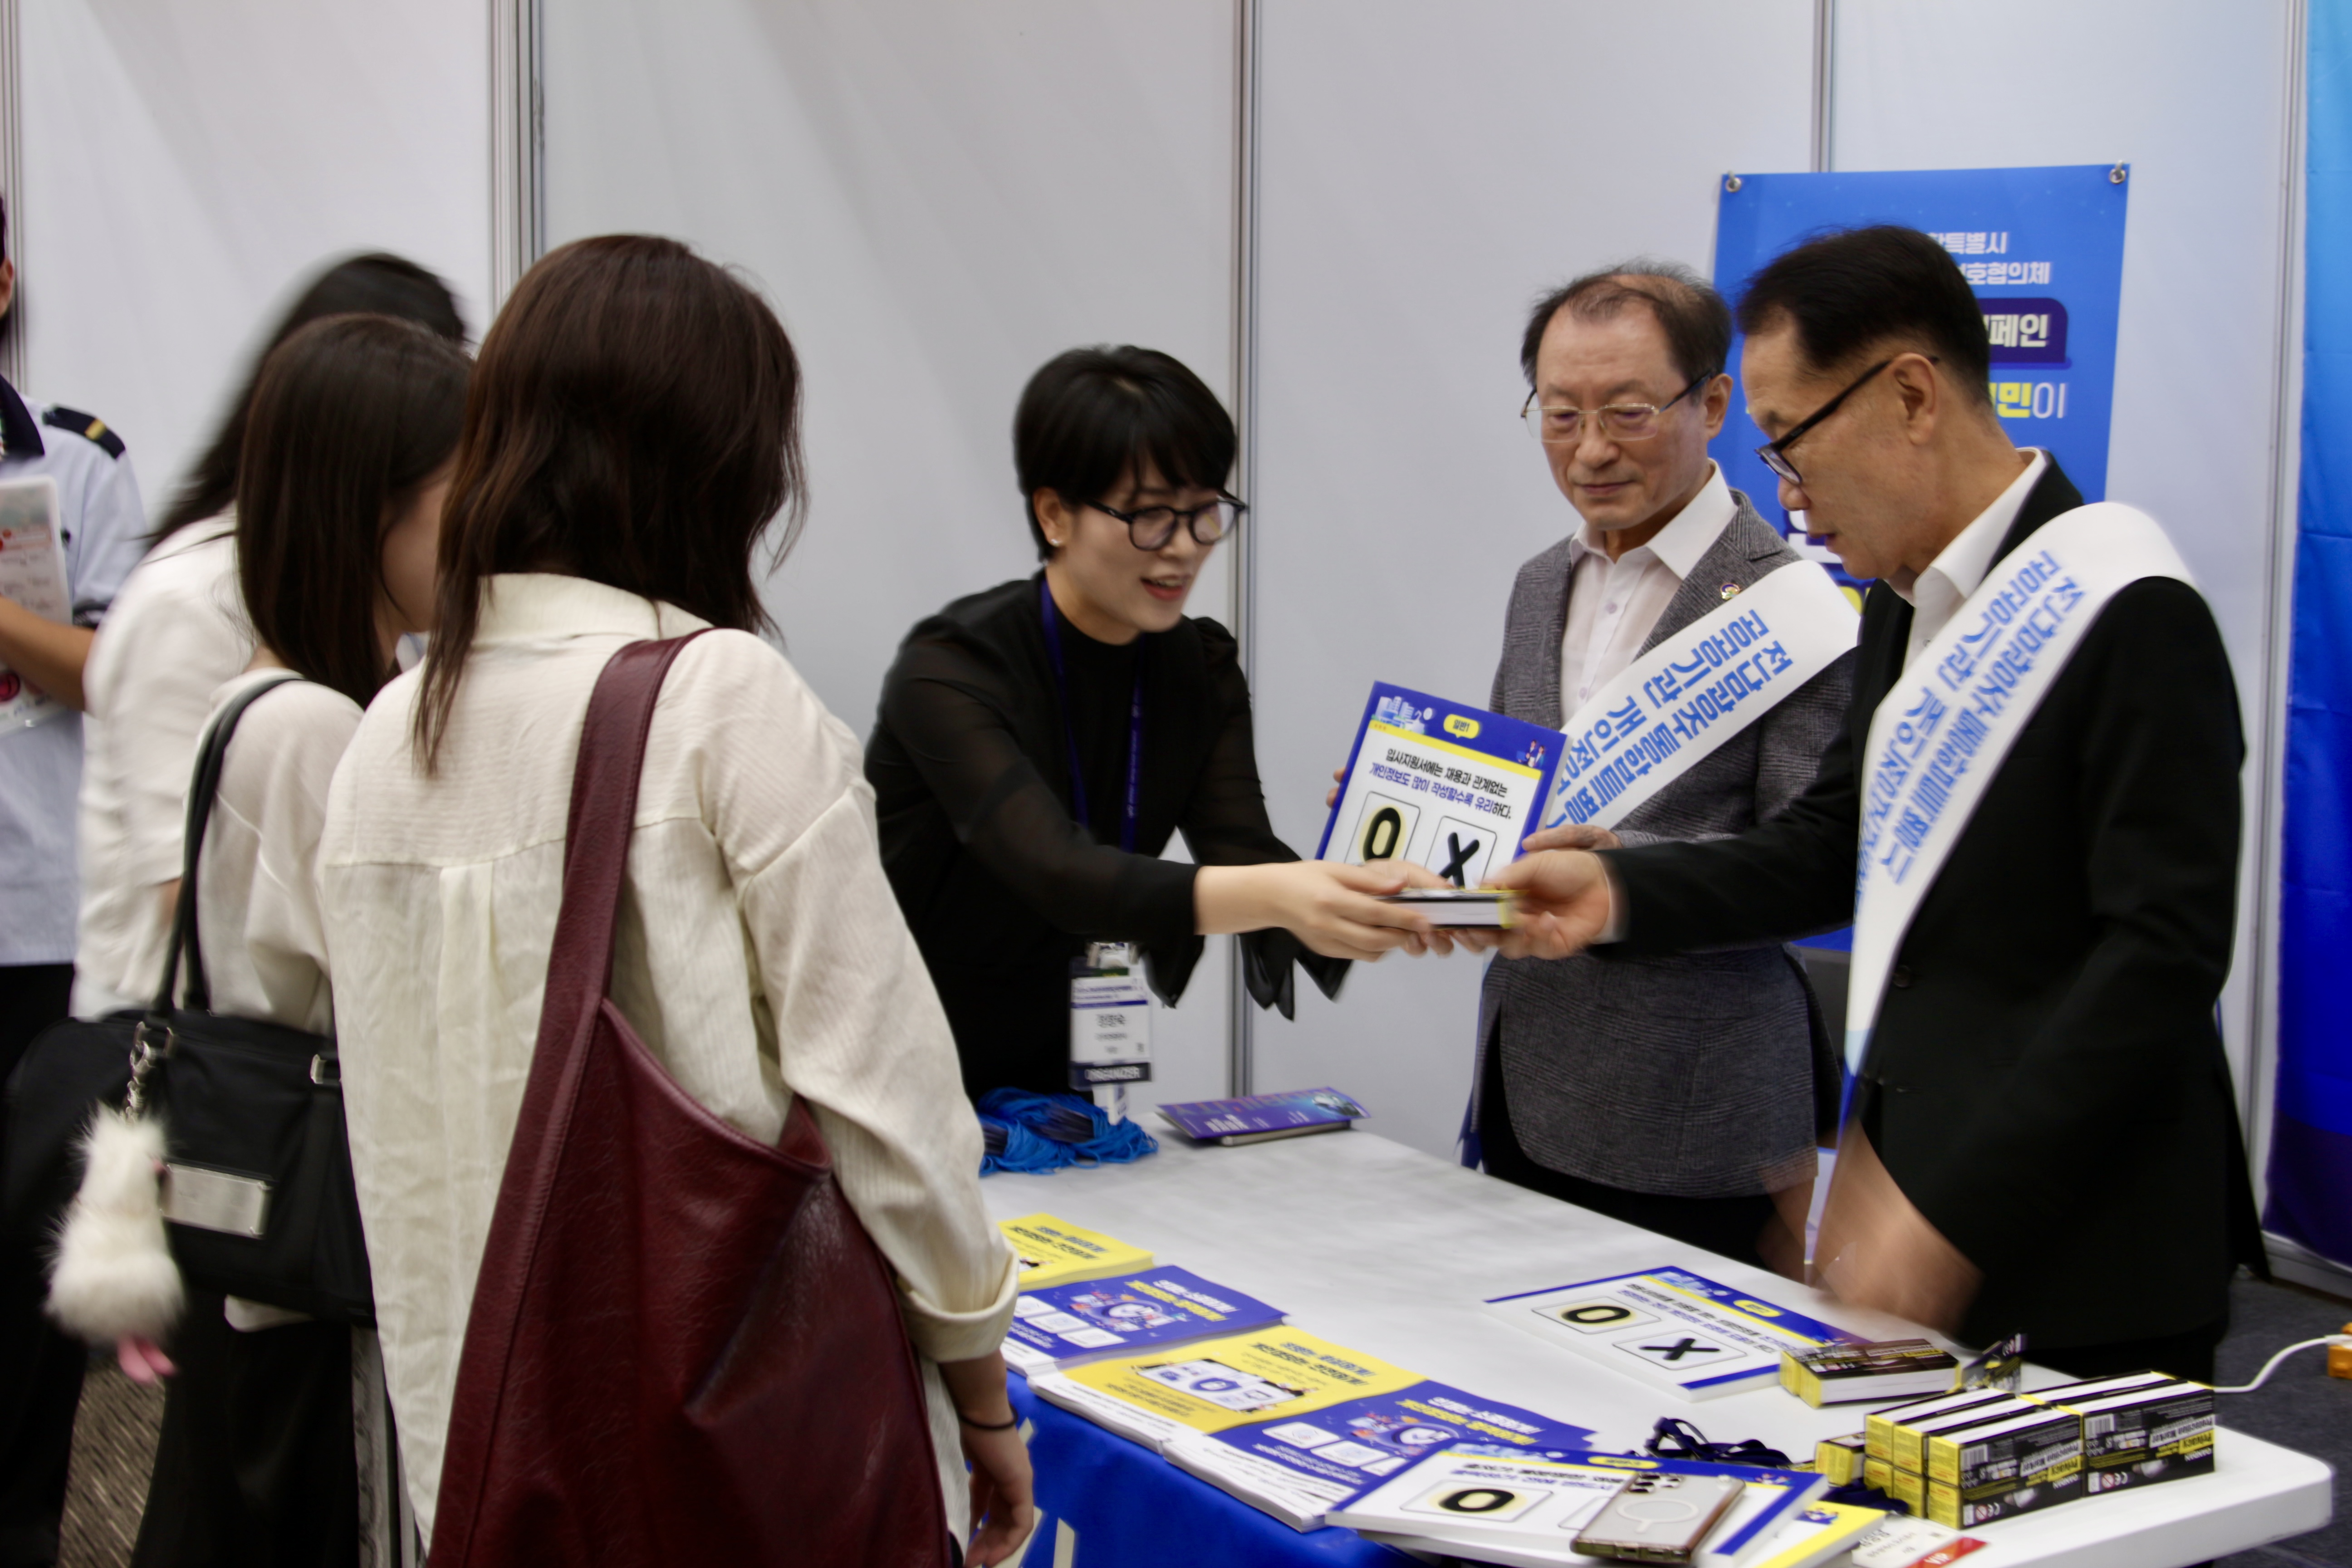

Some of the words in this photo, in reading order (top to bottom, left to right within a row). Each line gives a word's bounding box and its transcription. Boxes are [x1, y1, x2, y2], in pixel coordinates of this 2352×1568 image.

[1983, 314, 2048, 347] 페인
[1989, 382, 2067, 419] 민이
[1643, 609, 1769, 709] 공공기관
[1369, 762, 1411, 786] 개인정보도
[1411, 776, 1431, 792] 많이
[1431, 782, 1475, 807] 작성할수록
[1386, 749, 1443, 778] 입사지원서에는
[1444, 767, 1471, 786] 채용과
[1472, 776, 1508, 798] 관계없는
[1085, 1067, 1140, 1082] ORGANIZER
